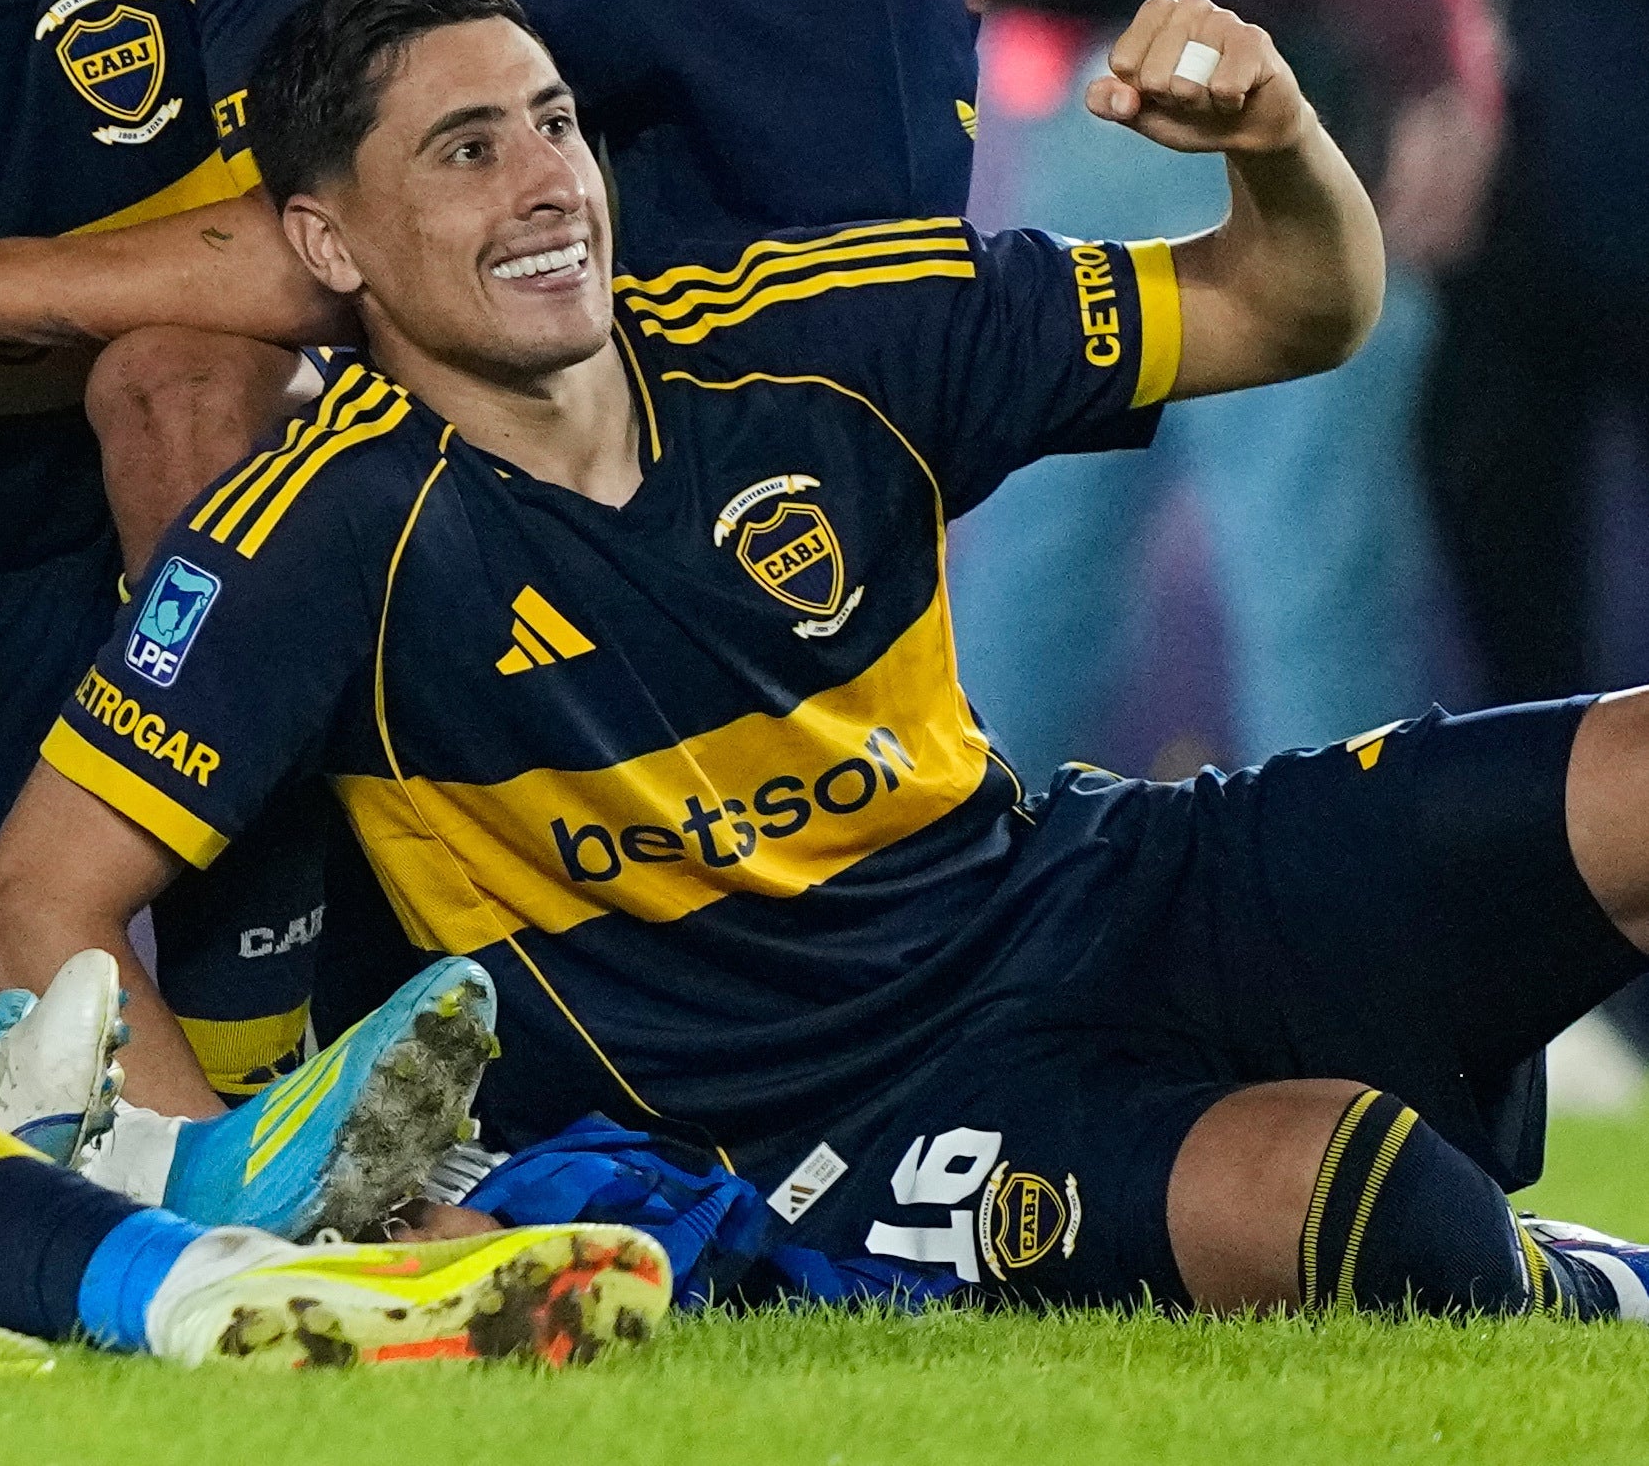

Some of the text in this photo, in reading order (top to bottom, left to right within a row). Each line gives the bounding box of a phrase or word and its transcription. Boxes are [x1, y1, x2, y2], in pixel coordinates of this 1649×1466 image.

[81, 42, 152, 81] CABJ
[1070, 245, 1122, 368] CETRO
[764, 534, 826, 580] CABJ
[127, 634, 178, 677] LPF
[75, 663, 221, 788] ETROGAR
[550, 726, 915, 884] betsson
[864, 1126, 1003, 1283] 16
